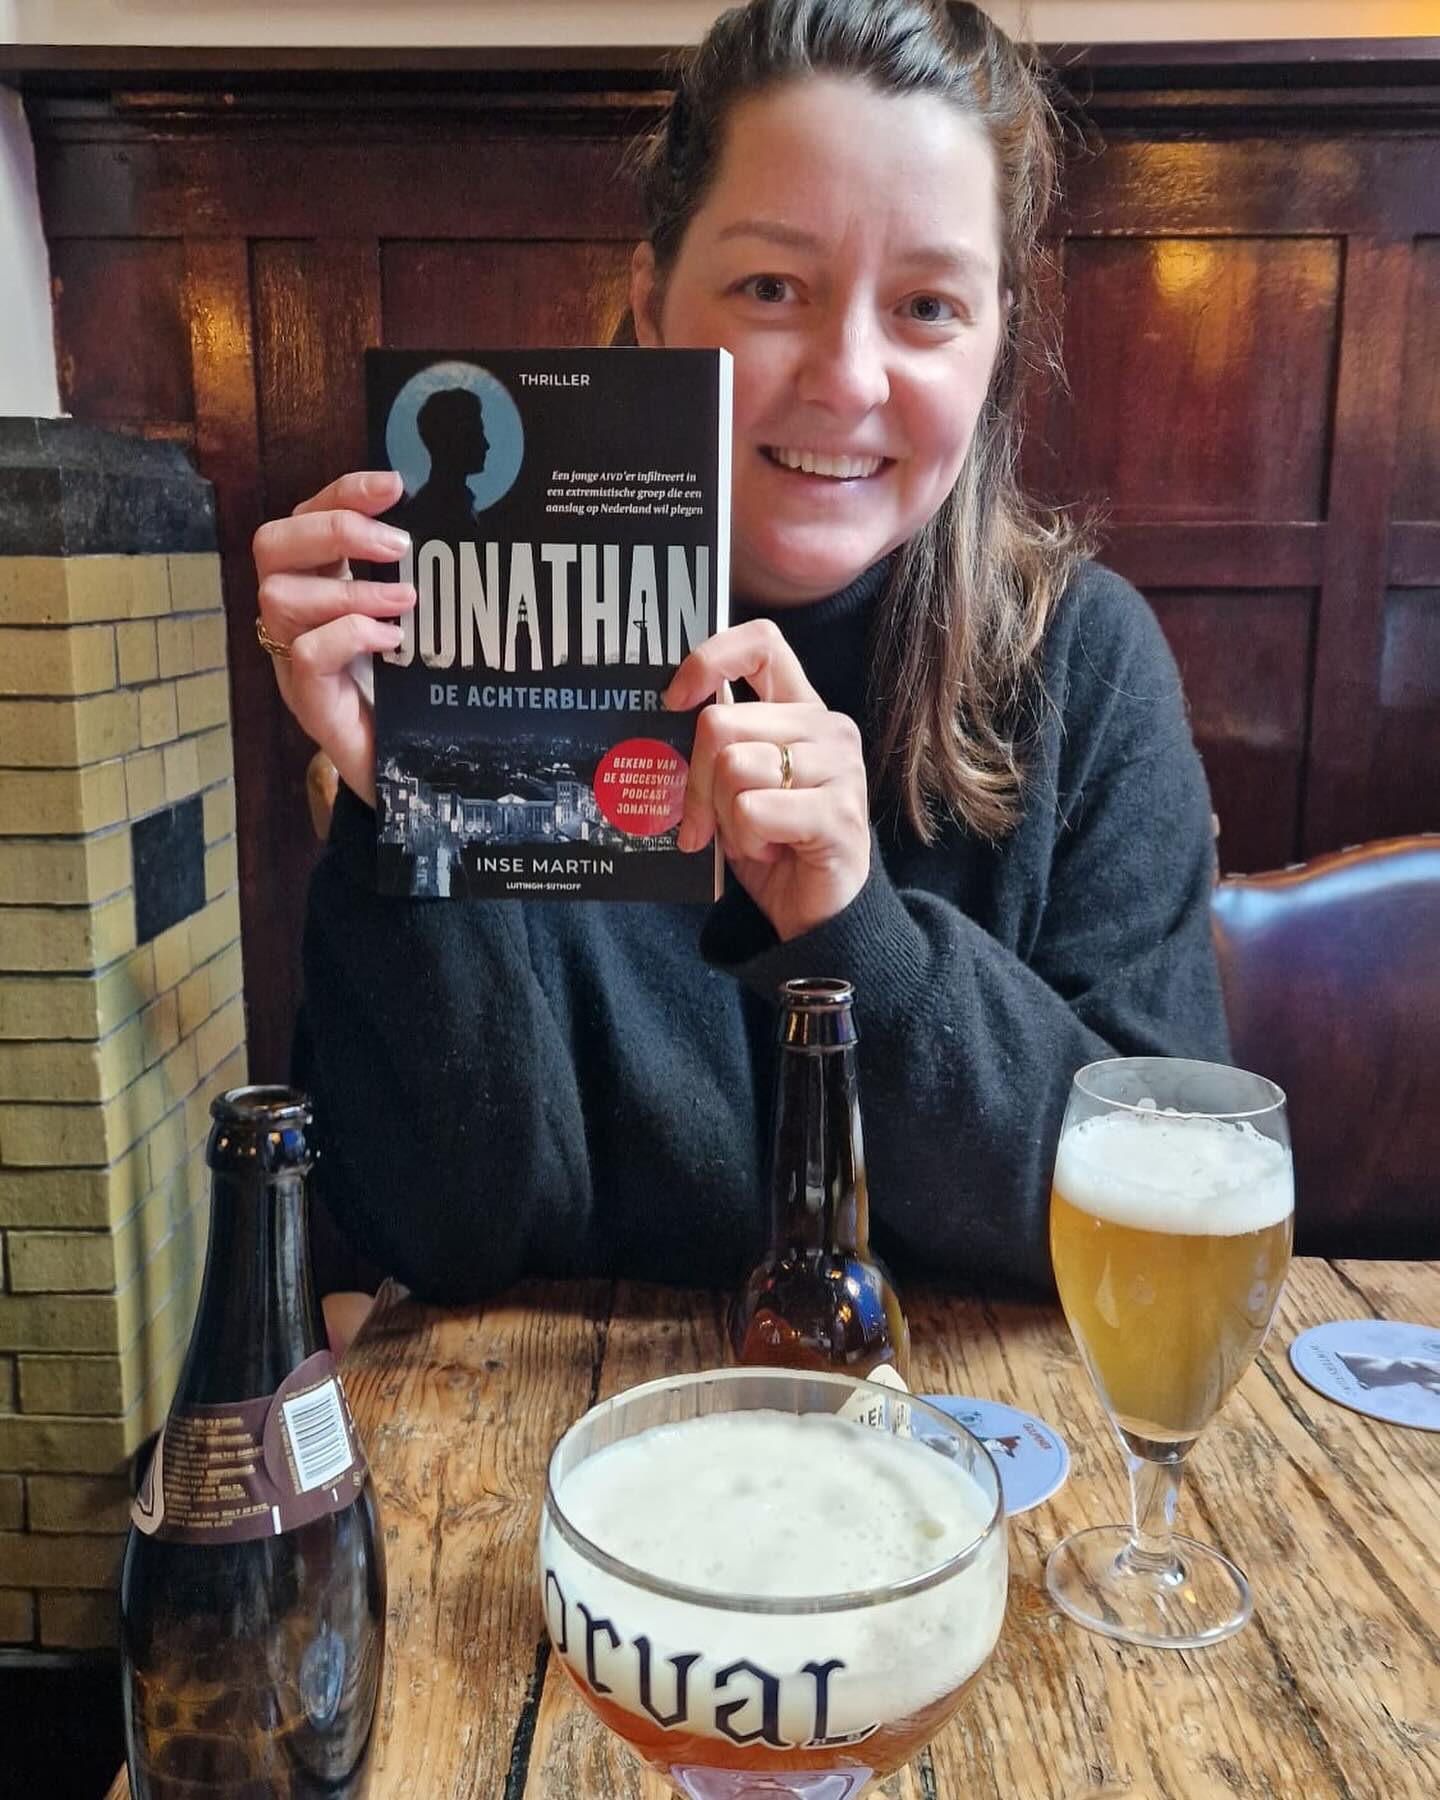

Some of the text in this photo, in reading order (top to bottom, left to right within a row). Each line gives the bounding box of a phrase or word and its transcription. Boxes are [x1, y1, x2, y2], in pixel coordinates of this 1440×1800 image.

[519, 373, 591, 387] THRILLER
[552, 470, 570, 481] Een
[569, 470, 599, 484] jonge
[686, 470, 697, 482] in
[546, 486, 703, 501] een extremistische groep die een
[545, 502, 704, 518] aanslag op Nederland wil plegen
[382, 539, 709, 672] JONATHAN
[429, 684, 459, 707] DE
[613, 757, 678, 770] BEKEND VAN
[603, 772, 617, 784] DE
[622, 788, 667, 801] PODCAST
[616, 803, 671, 816] JONATHAN
[476, 857, 614, 875] INSE MARTIN
